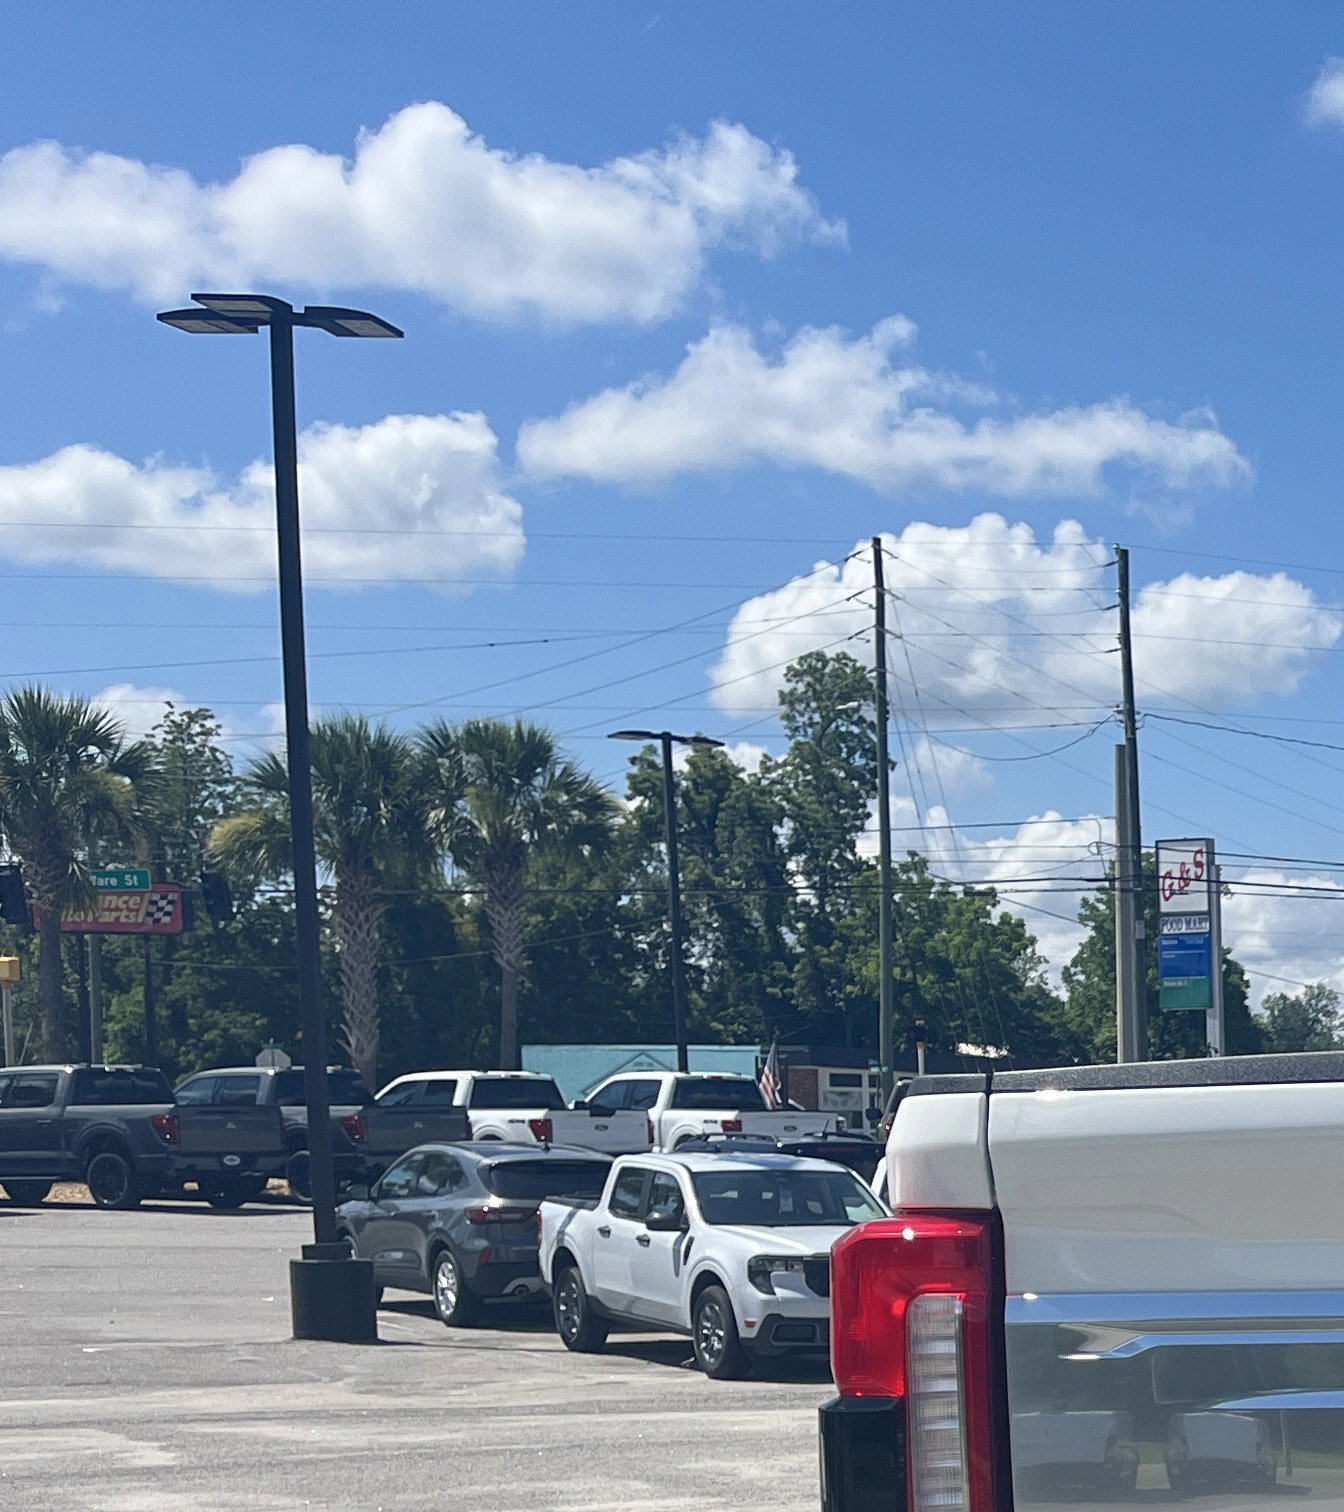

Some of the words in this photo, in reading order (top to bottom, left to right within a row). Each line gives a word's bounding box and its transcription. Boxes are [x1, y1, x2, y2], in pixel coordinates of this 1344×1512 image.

[124, 874, 139, 887] St
[1160, 917, 1183, 932] FOOD
[1184, 916, 1209, 931] MART
